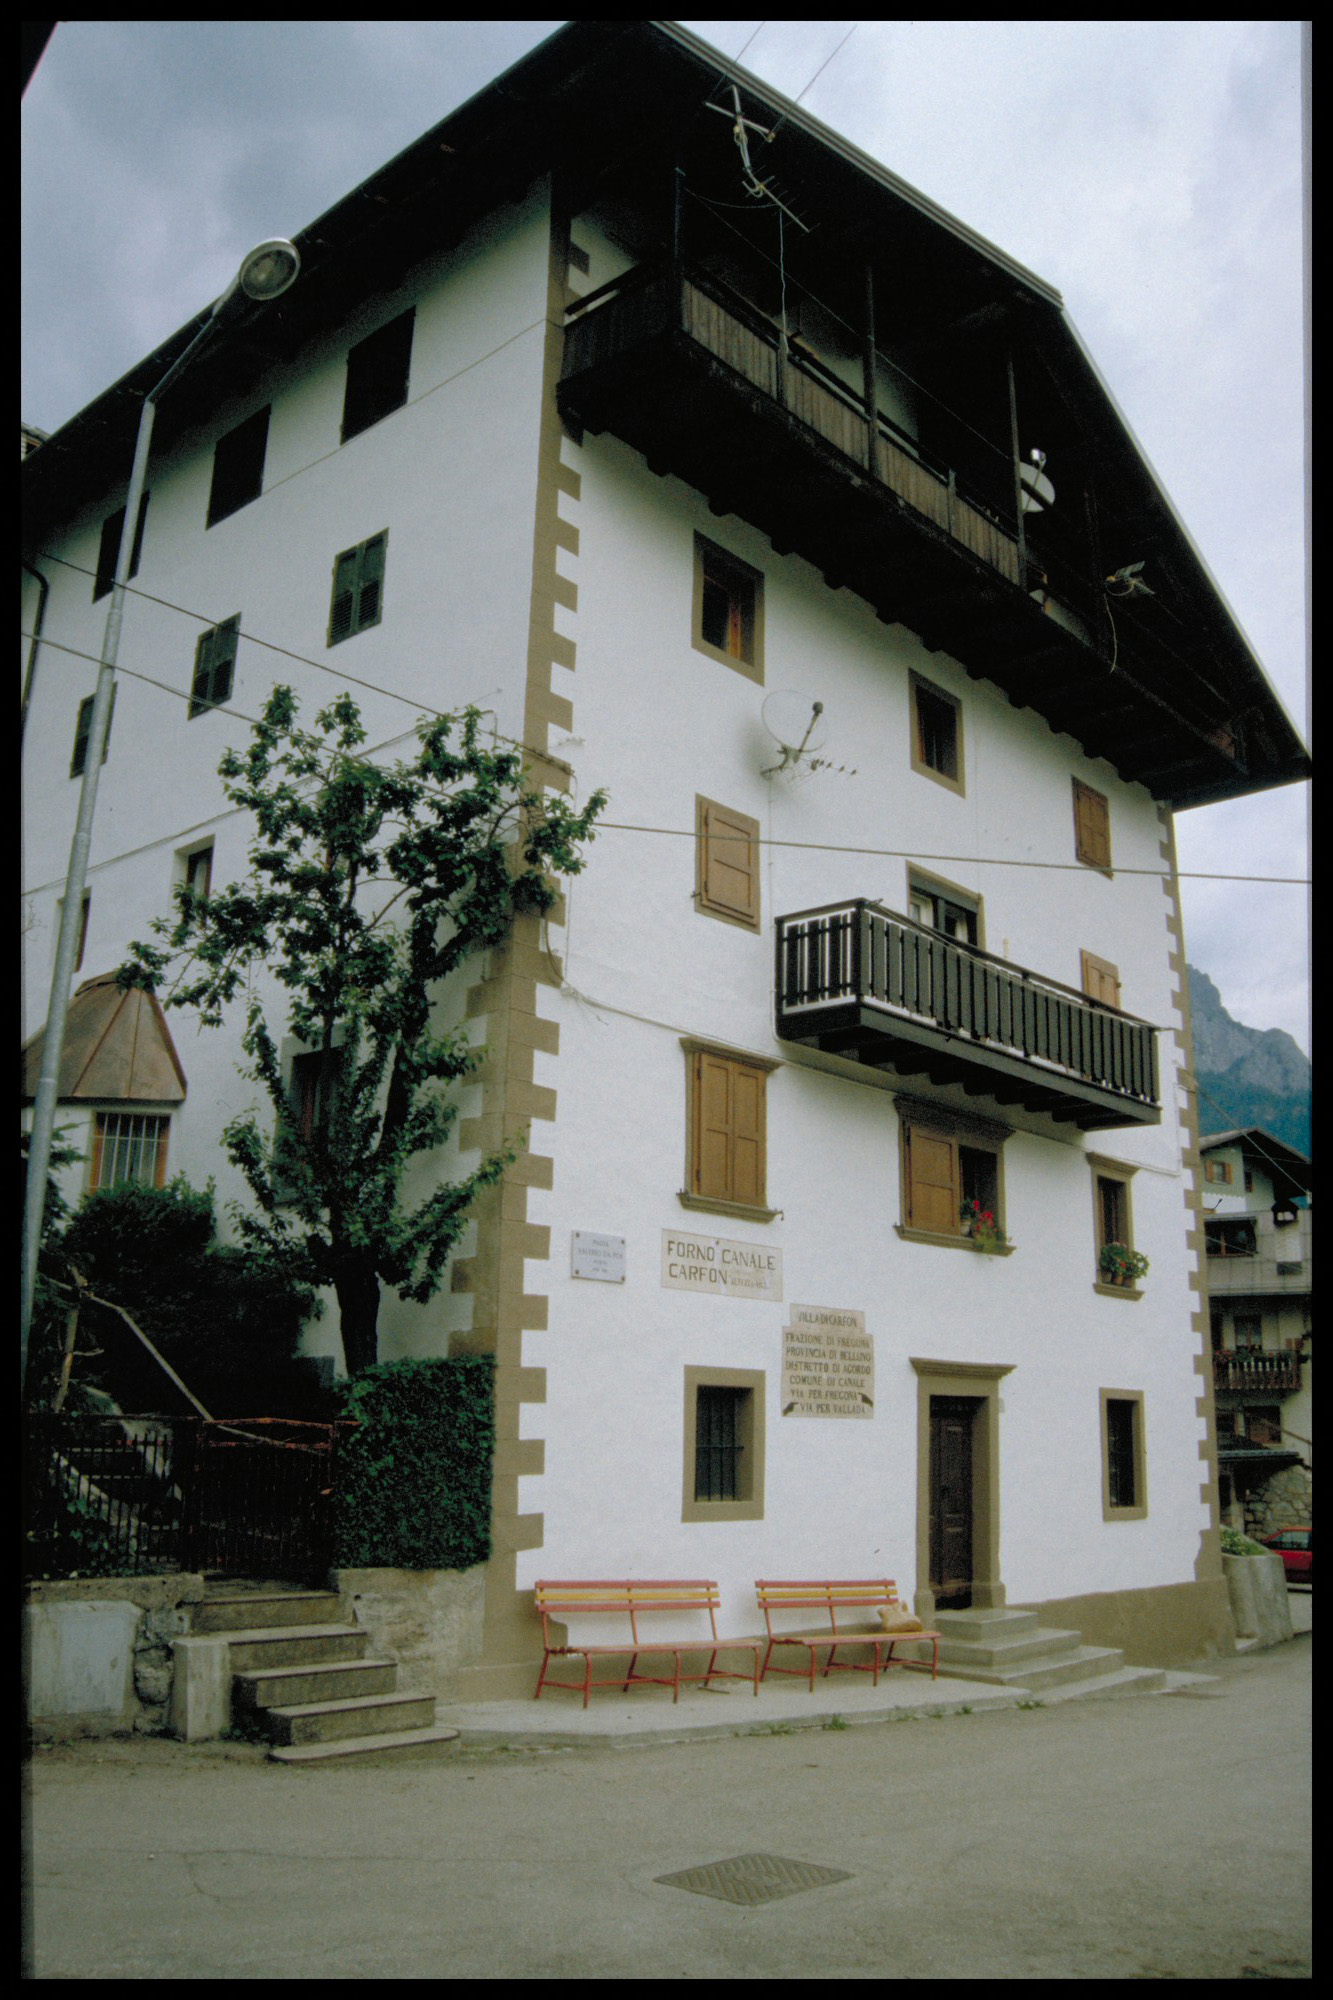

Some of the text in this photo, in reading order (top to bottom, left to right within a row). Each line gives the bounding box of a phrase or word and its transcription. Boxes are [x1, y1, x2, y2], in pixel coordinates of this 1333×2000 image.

[668, 1240, 776, 1271] FORNO CANALE
[668, 1262, 728, 1285] CARFON
[821, 1314, 828, 1324] DI
[828, 1315, 857, 1327] CARFON
[786, 1333, 870, 1348] FRAZIONE DI FREGONA
[786, 1347, 871, 1362] PROVINCIA DI BELLUNO
[786, 1361, 870, 1374] DISTRETTO DI AGORDO
[790, 1376, 866, 1388] COMUNE DI CANALE
[790, 1389, 858, 1400] VIA PER FREGONA
[800, 1403, 866, 1415] VIA PER VALLADA
